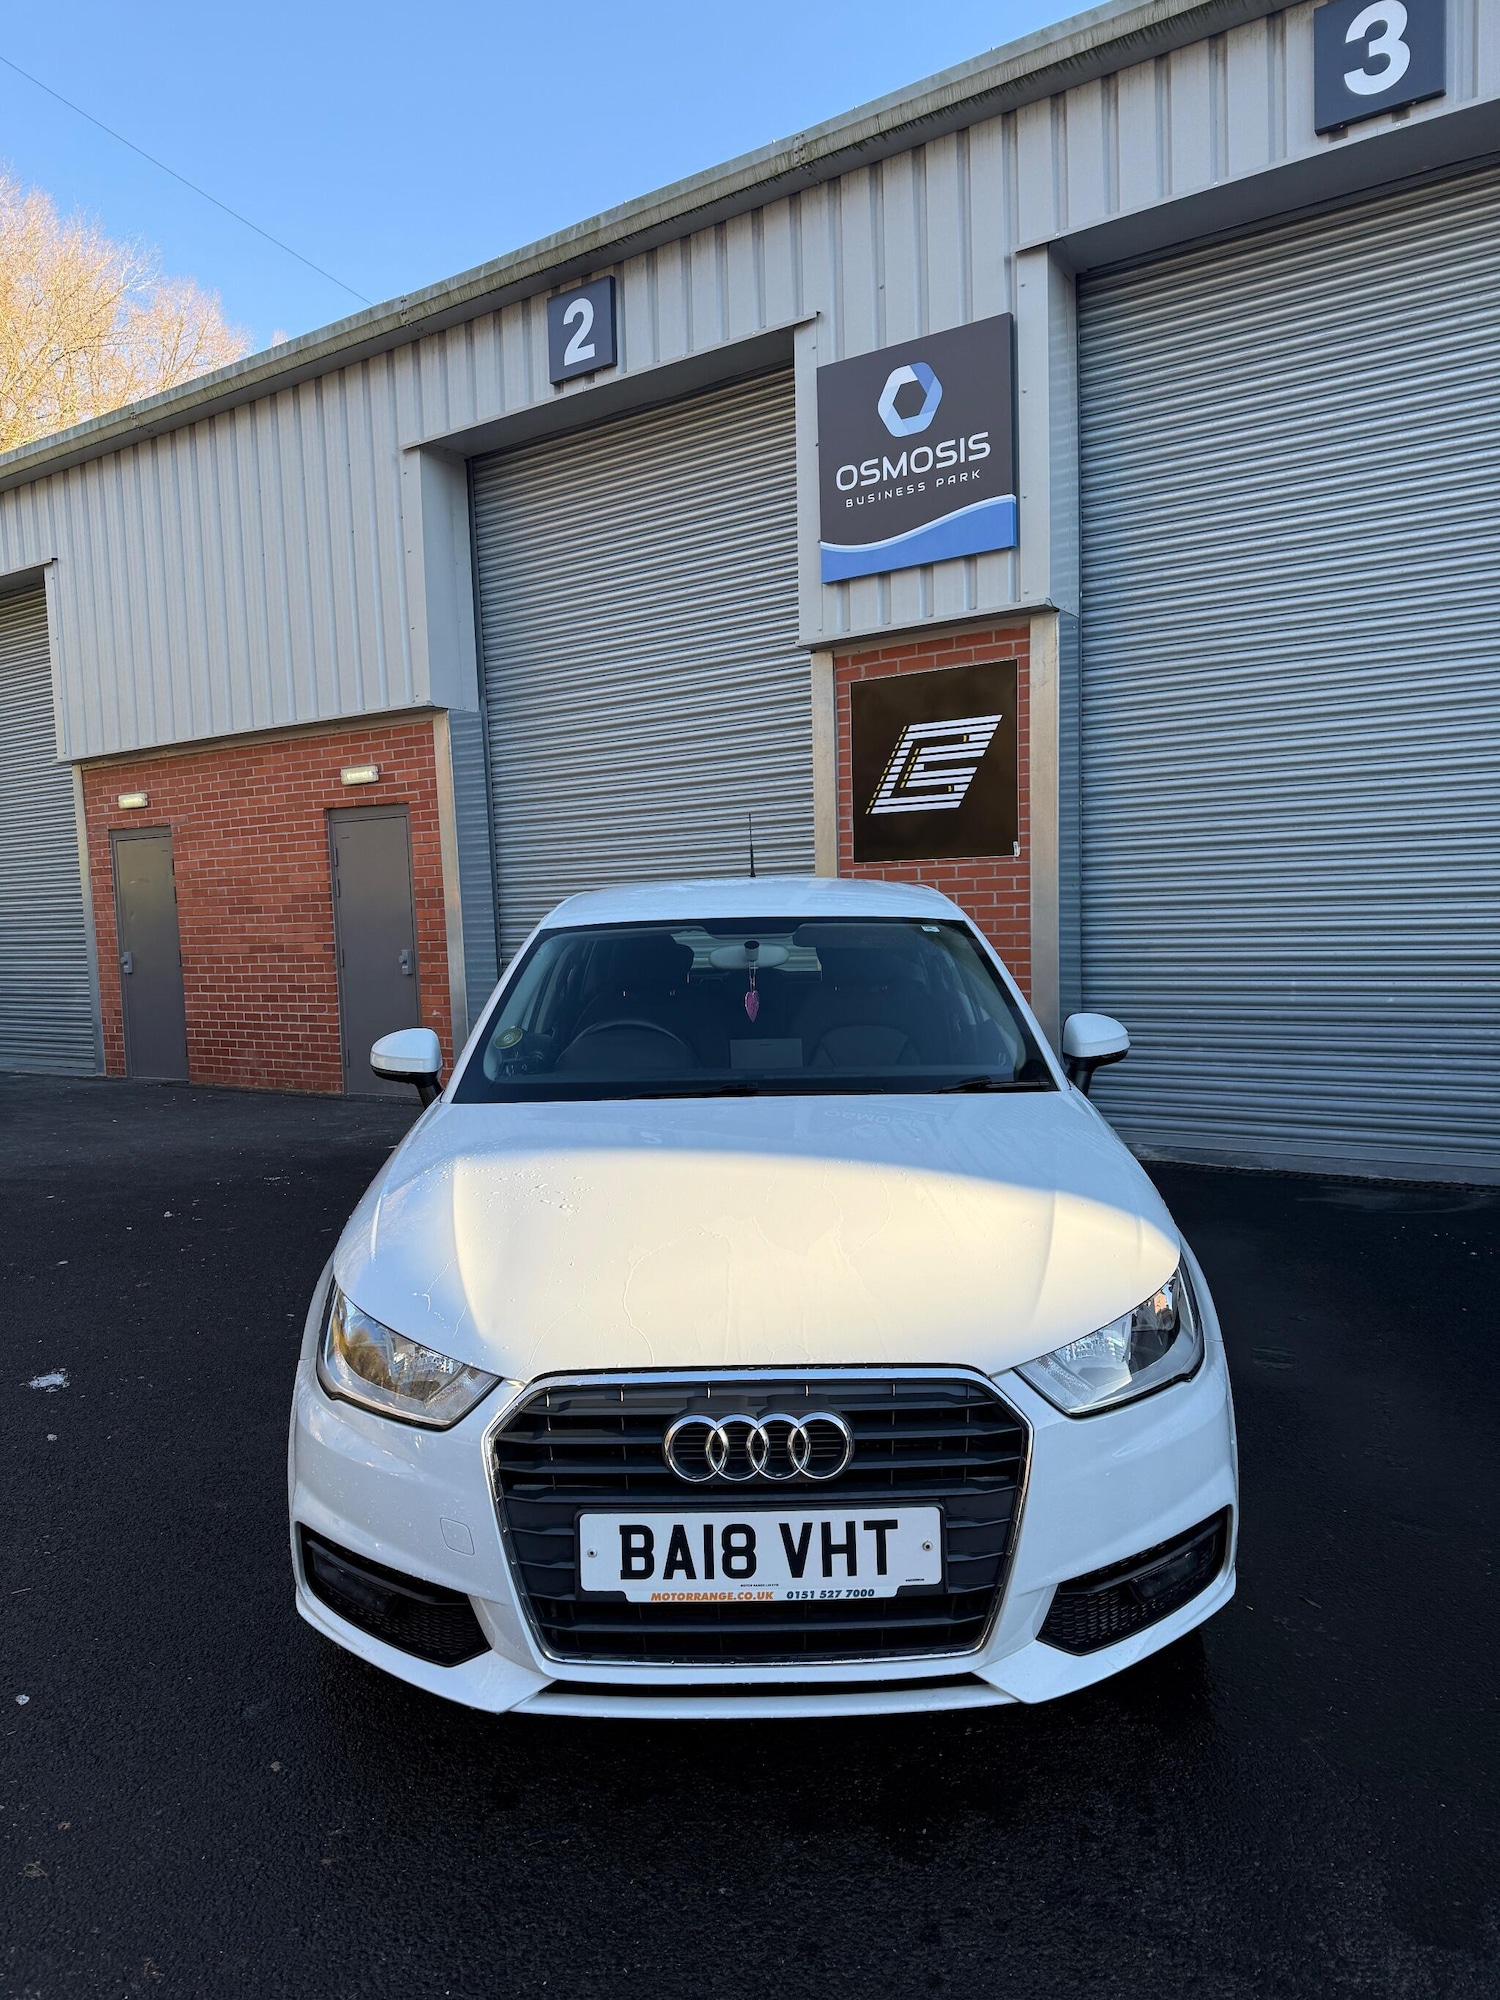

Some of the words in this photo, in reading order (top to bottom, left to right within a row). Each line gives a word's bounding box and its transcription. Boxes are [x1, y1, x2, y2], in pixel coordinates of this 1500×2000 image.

[1344, 0, 1411, 95] 3
[563, 298, 596, 367] 2
[835, 431, 991, 491] OSMOSIS
[845, 481, 926, 508] BUSINESS
[935, 469, 981, 488] PARK
[619, 1523, 757, 1580] BA18
[778, 1519, 899, 1579] VHT
[650, 1591, 774, 1602] MOTORRANGE.CO.UK
[786, 1590, 815, 1600] 0151
[819, 1589, 843, 1599] 527
[845, 1588, 875, 1598] 7000
